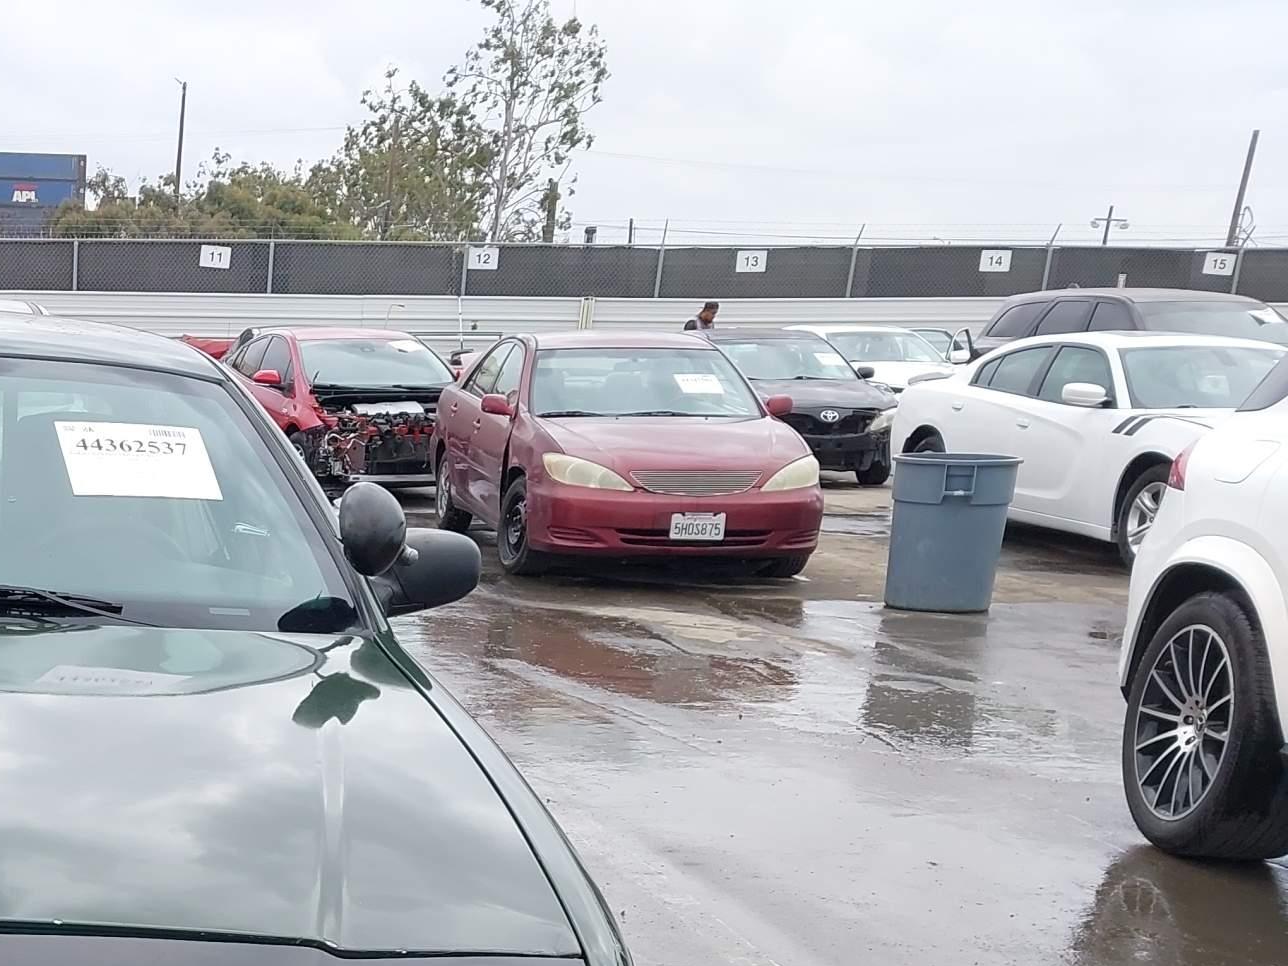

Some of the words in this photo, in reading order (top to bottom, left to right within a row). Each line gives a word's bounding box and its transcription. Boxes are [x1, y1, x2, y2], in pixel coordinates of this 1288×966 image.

[12, 190, 38, 203] APL
[208, 251, 223, 263] 11
[476, 253, 491, 265] 12
[744, 255, 759, 268] 13
[988, 255, 1003, 268] 14
[1212, 258, 1227, 270] 15
[75, 437, 187, 455] 44362537
